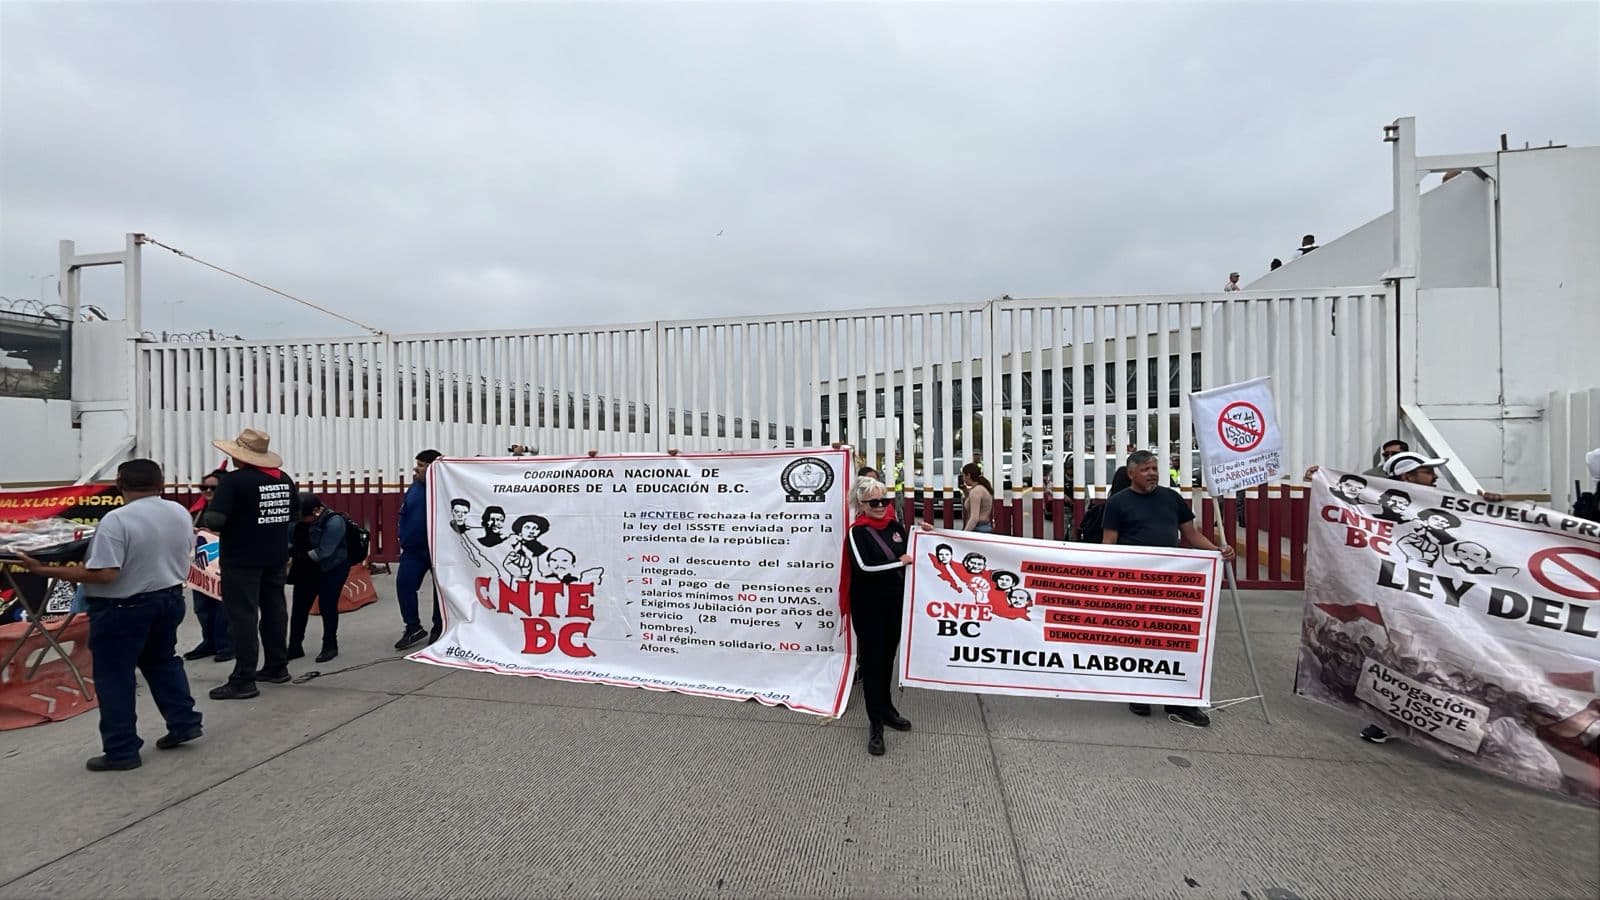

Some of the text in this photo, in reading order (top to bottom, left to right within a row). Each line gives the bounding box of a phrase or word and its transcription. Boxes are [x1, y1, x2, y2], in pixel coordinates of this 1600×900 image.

[1226, 411, 1254, 421] Ley del
[1232, 430, 1258, 446] 2007
[524, 468, 720, 480] COORDINADORA NACIONAL DE
[492, 481, 749, 494] TRABAJADORES DE LA EDUCACIÓN B.C.
[623, 511, 636, 519] La
[640, 511, 694, 520] #CNTEBC
[697, 512, 746, 520] rechaza
[750, 512, 762, 520] la
[766, 512, 818, 521] reforma
[1440, 494, 1552, 528] ESCUELA
[623, 522, 833, 534] la ley del ISSSTE enviada por la
[1320, 504, 1394, 539] CNTE
[622, 534, 790, 547] presidenta de la república:
[1344, 527, 1392, 556] BC
[641, 566, 696, 578] integrado.
[642, 554, 834, 570] NO al descuento del salario
[1026, 564, 1202, 584] ABROGACIÓN LEY DEL ISSSTE 2007
[642, 577, 834, 594] SI al pago de pensiones en
[1031, 578, 1201, 600] JUBILACIONES Y PENSIONES DIGNAS
[475, 576, 596, 621] CNTE
[641, 588, 821, 606] salarios mínimos NO en UMAS.
[1042, 596, 1200, 616] SISTEMA SOLIDARIO DE PENSIONES
[1376, 558, 1600, 639] LEY DEL
[641, 599, 834, 618] Exigimos Jubilación por años de
[926, 601, 992, 622] CNTE
[640, 611, 834, 630] servicio (28 mujeres y 30
[640, 622, 696, 635] hombres).
[936, 620, 980, 638] BC
[1053, 612, 1194, 633] CESE AL ACOSO LABORAL
[520, 618, 597, 658] BC
[642, 632, 654, 642] SI
[656, 634, 666, 642] al
[669, 634, 716, 648] régimen
[719, 639, 776, 652] solidario,
[779, 642, 800, 652] NO
[816, 644, 834, 652] las
[1049, 630, 1192, 650] DEMOCRATIZACIÓN DEL SNTE
[640, 643, 680, 655] Afores.
[950, 645, 1186, 677] JUSTICIA LABORAL
[1368, 663, 1476, 720] Abrogación
[1372, 680, 1470, 732] Ley ISSSTE
[1388, 703, 1442, 733] 2007
